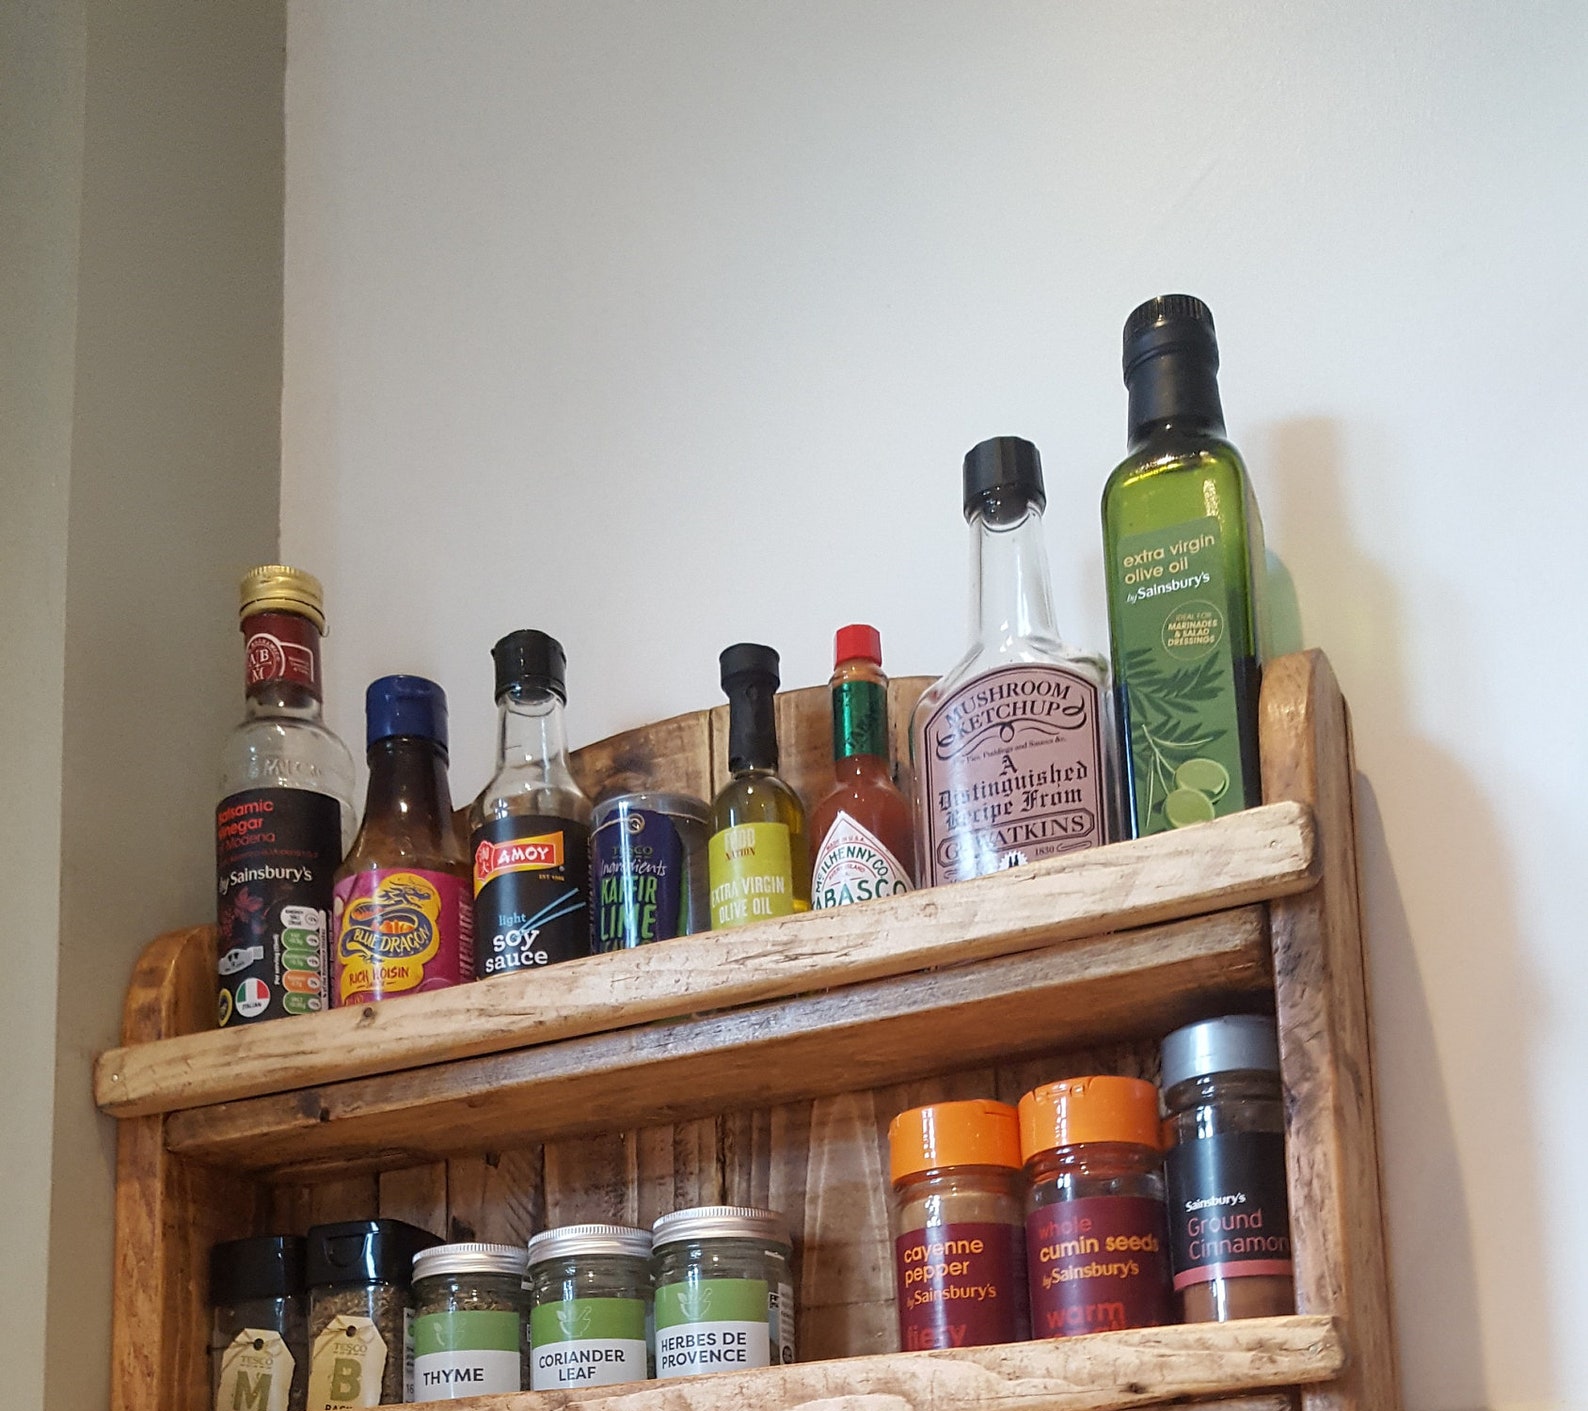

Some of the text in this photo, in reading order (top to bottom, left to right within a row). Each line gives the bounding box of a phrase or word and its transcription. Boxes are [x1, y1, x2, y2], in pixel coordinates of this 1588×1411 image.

[1123, 534, 1215, 568] extra virgin
[1124, 556, 1189, 584] olive oil
[1167, 619, 1219, 631] MARINADES
[1182, 628, 1210, 637] SALAD
[1167, 635, 1216, 647] DRESSINGS
[944, 680, 1072, 727] MUSHROOM
[957, 700, 1061, 739] KETCHUP
[999, 754, 1018, 777] A
[938, 760, 1089, 812] Distinguished
[1019, 787, 1083, 813] From
[977, 814, 1085, 847] WATKINS
[497, 845, 551, 866] AMOY
[612, 846, 653, 855] TCO
[230, 864, 314, 887] Sainsbury's
[600, 858, 668, 880] Ingrients
[711, 875, 785, 909] EXTRA VIRGIN
[812, 878, 908, 911] ABASCO
[498, 911, 527, 927] light
[601, 904, 657, 941] LIME
[719, 896, 773, 924] OLIVE OIL
[353, 928, 379, 948] BLUE
[379, 924, 431, 953] DRAGON
[492, 929, 540, 953] soy
[485, 950, 549, 974] sauce
[348, 970, 370, 986] RICH
[1038, 1216, 1093, 1240] whole
[1187, 1208, 1263, 1237] Ground
[903, 1237, 985, 1263] cayenne
[1039, 1235, 1100, 1263] cumin
[1188, 1235, 1290, 1261] Cinnamon
[904, 1259, 971, 1288] pepper
[1051, 1259, 1140, 1284] Sainsbury's
[914, 1283, 998, 1305] Sainsbury's
[1046, 1302, 1126, 1329] warm
[660, 1332, 747, 1353] HERBES DE
[538, 1349, 626, 1369] CORIANDER
[661, 1349, 747, 1370] PROVENCE
[329, 1357, 363, 1402] B
[423, 1368, 485, 1387] THYME
[558, 1366, 597, 1383] LEAF
